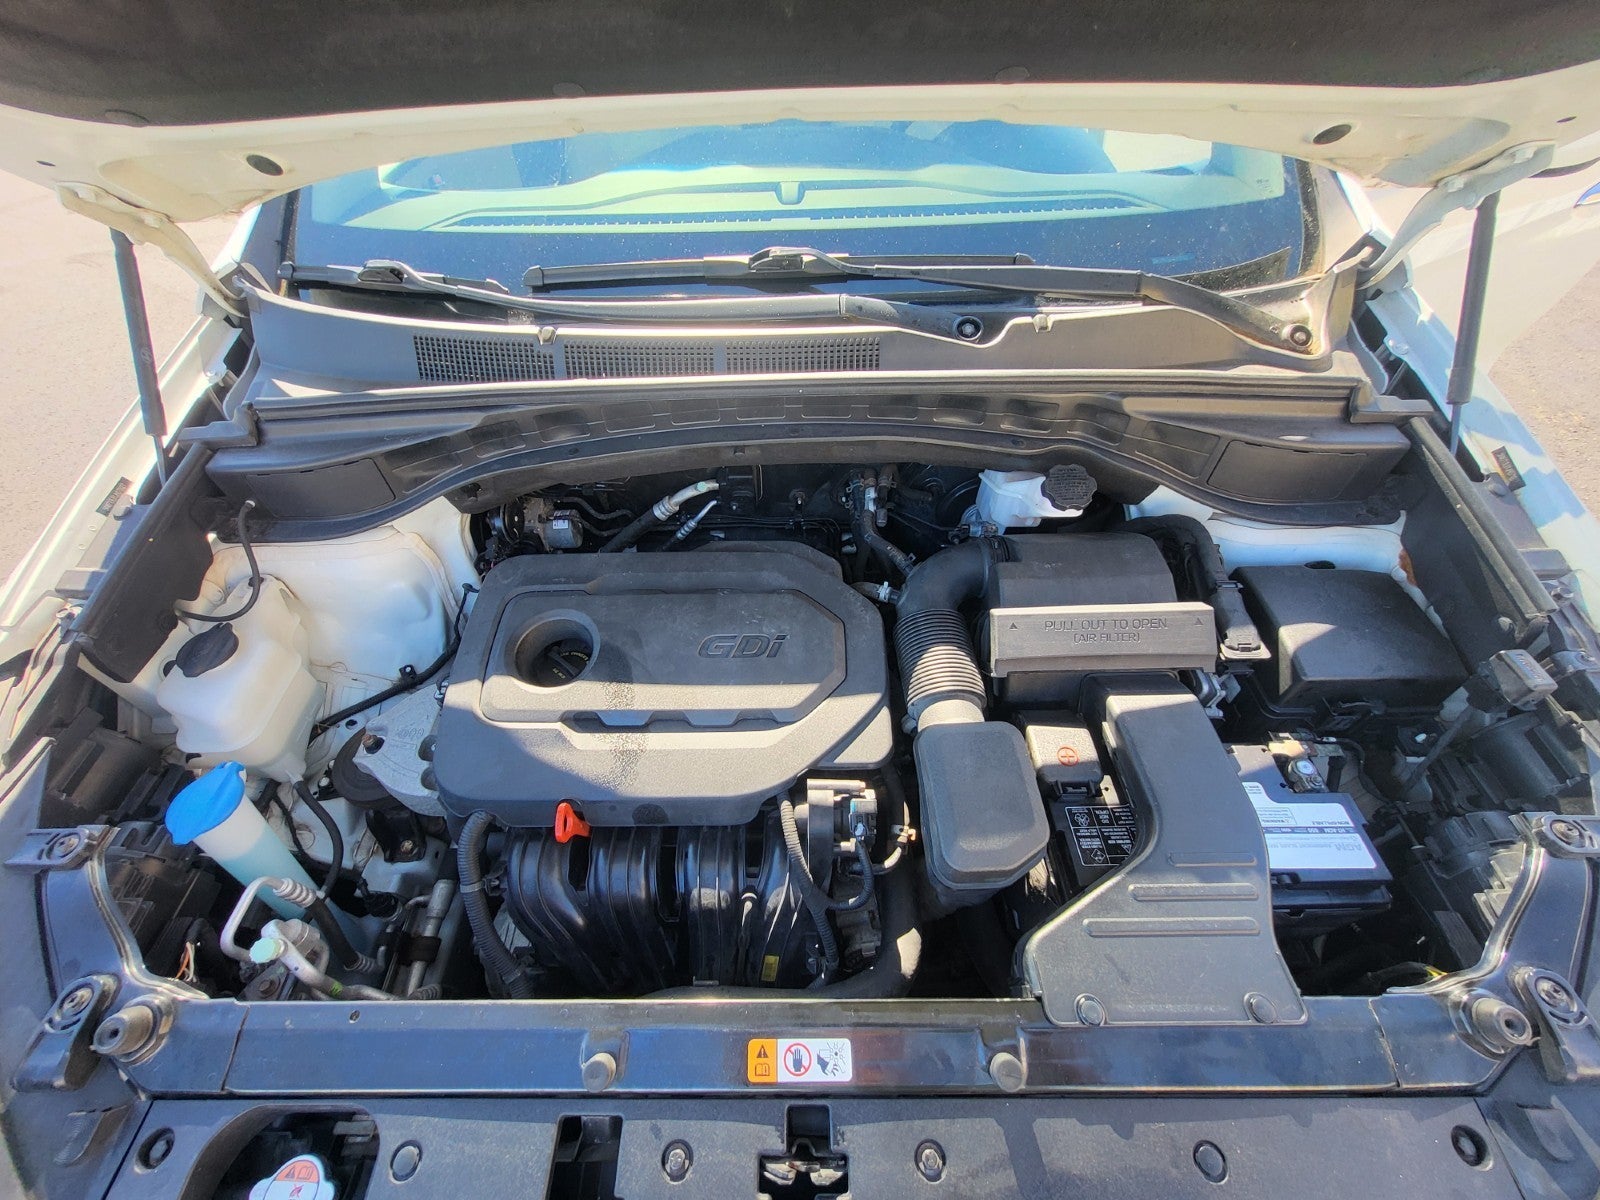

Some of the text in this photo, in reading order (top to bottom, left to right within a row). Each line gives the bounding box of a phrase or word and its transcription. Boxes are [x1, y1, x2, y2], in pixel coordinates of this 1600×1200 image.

[1044, 617, 1168, 631] PULL OUT TO OPEN
[1073, 632, 1141, 645] (AIR FILTER)
[697, 633, 788, 659] GDi
